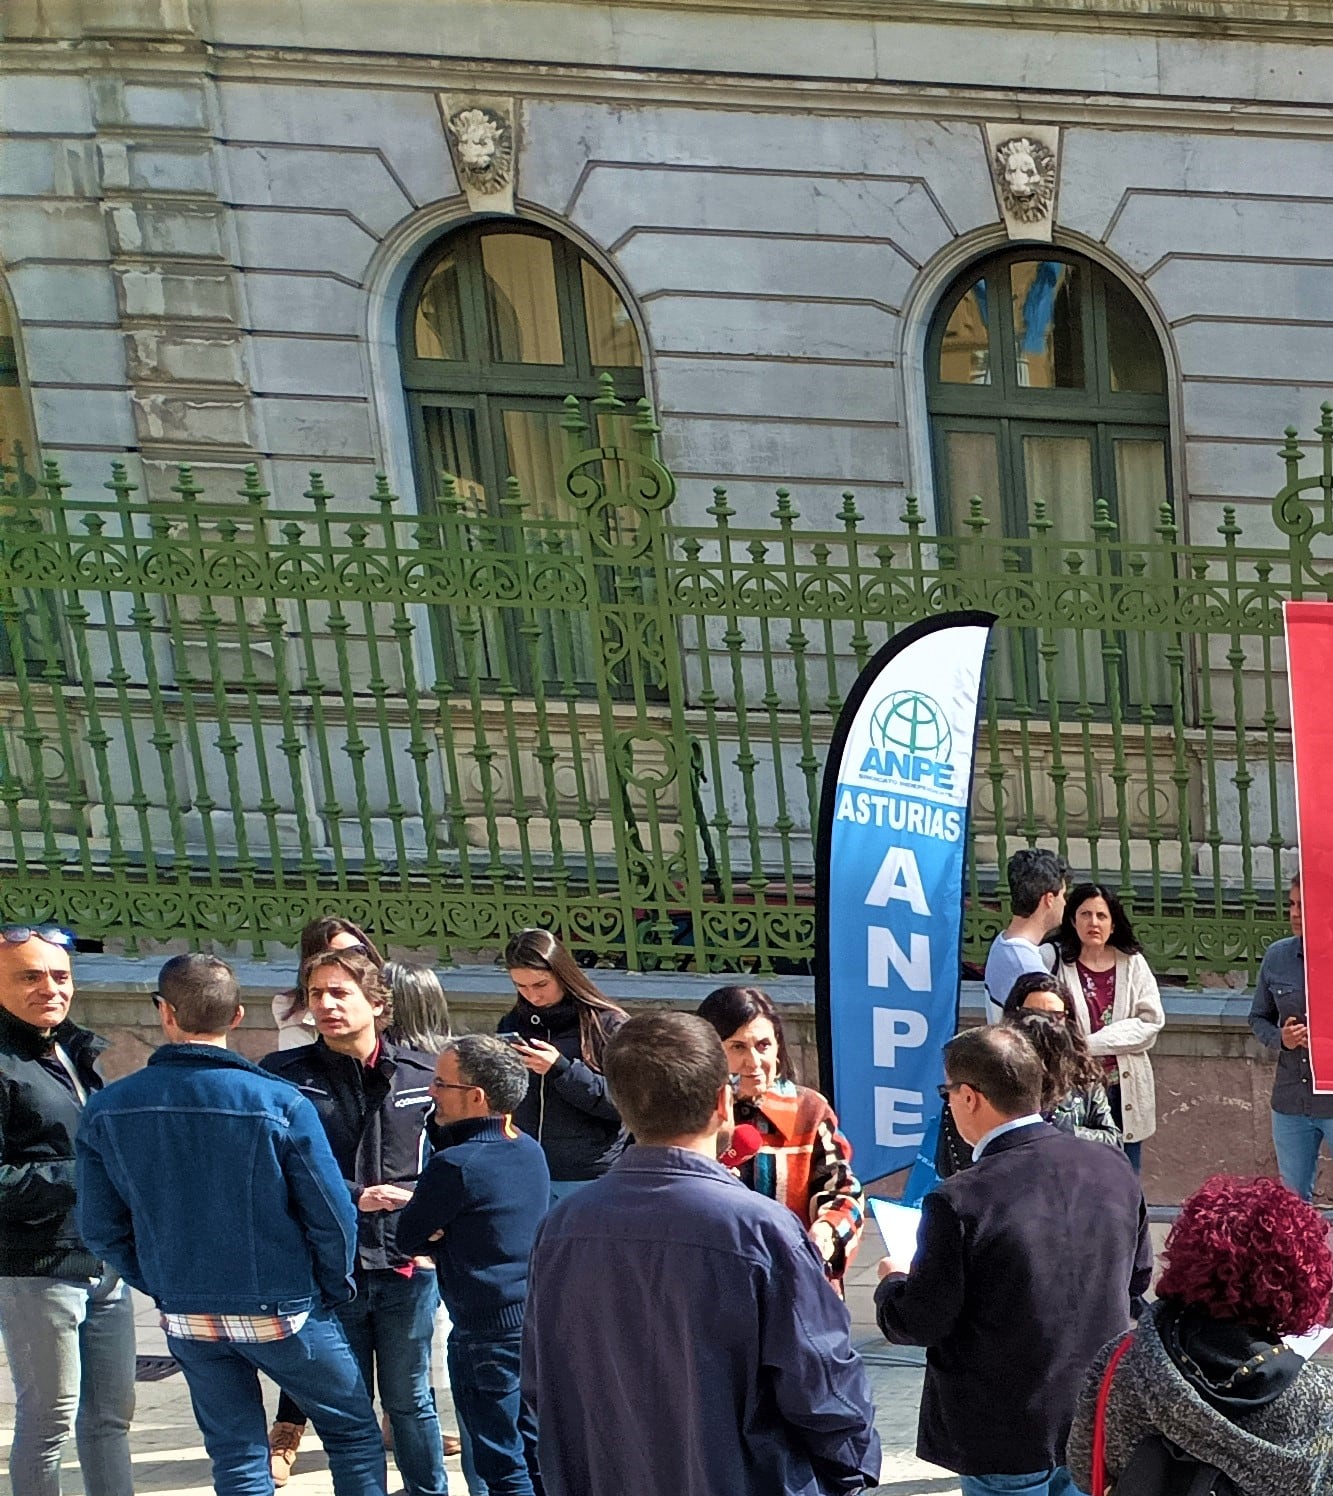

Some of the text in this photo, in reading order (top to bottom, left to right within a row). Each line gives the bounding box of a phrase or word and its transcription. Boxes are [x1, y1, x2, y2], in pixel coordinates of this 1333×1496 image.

[860, 747, 955, 790] ANPE
[836, 790, 961, 842] ASTURIAS
[864, 846, 932, 1147] ANPE
